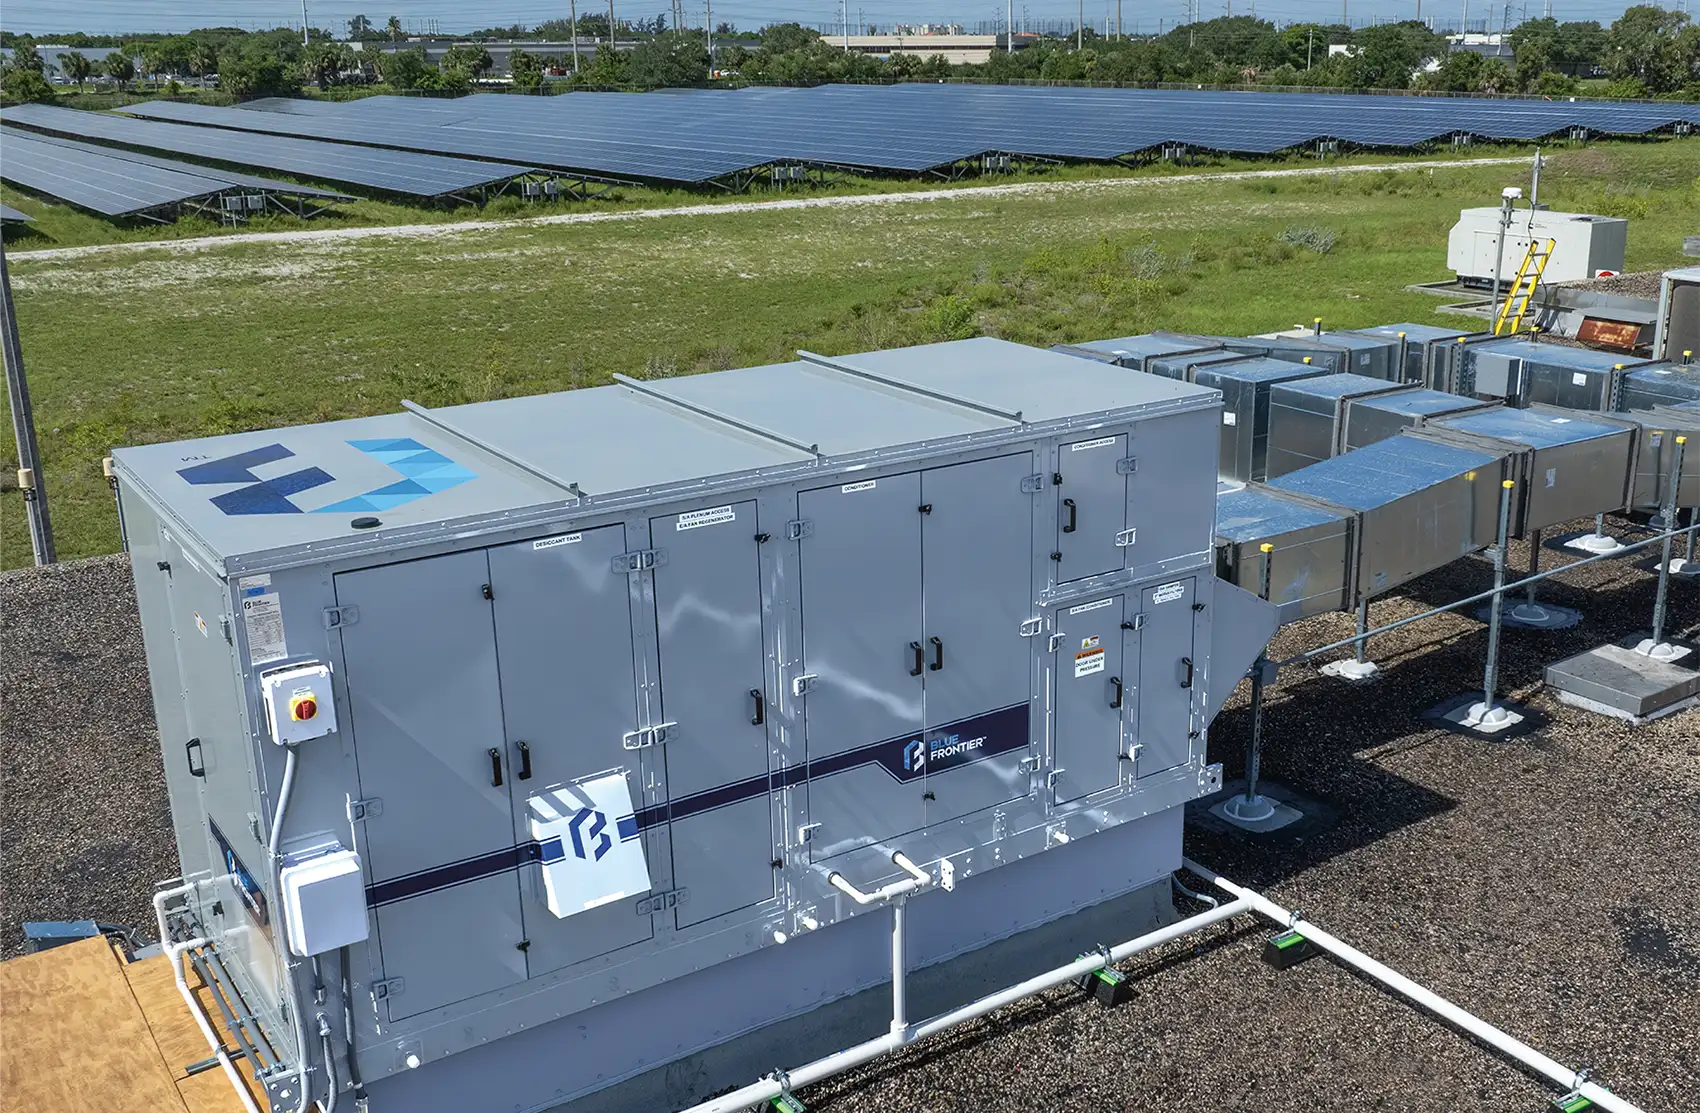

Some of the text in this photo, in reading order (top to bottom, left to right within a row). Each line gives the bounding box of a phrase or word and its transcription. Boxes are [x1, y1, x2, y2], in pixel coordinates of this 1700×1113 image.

[690, 511, 711, 519] PLENUM
[711, 507, 730, 515] ACCESS
[698, 514, 734, 525] REGENERATOR
[535, 537, 566, 548] DESICCANT
[1079, 664, 1101, 672] PRESSURE
[930, 734, 959, 751] BLUE
[930, 736, 986, 761] FRONTIER
